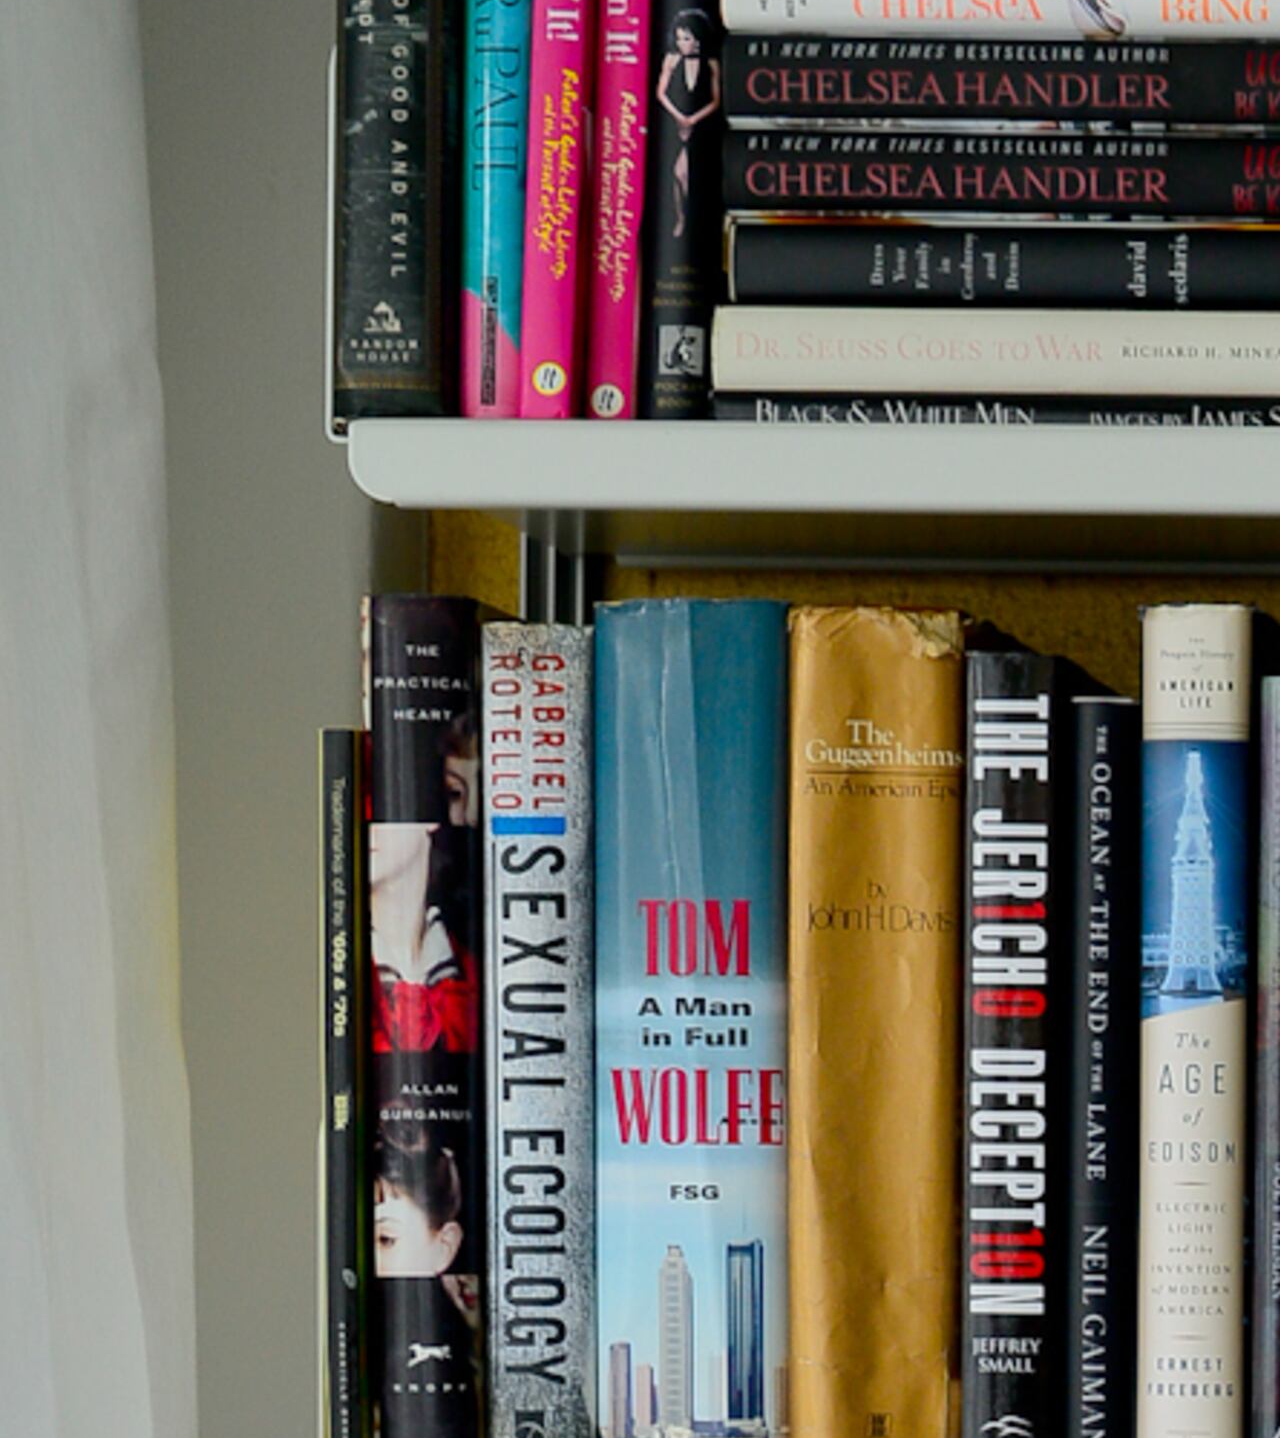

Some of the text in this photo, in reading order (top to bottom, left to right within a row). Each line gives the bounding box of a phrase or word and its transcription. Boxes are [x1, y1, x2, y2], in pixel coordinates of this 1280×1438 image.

[544, 13, 580, 43] It!
[746, 71, 1171, 110] CHELSEA HANDLER
[1121, 344, 1194, 358] RICHARD
[1200, 344, 1221, 358] H.
[638, 899, 752, 977] TOM
[638, 996, 752, 1018] A Man
[642, 1027, 749, 1048] in Full
[497, 844, 569, 1387] SEXUAL ECOLOGY
[669, 1184, 719, 1201] FSG
[1080, 1226, 1110, 1305] NEIL
[972, 1337, 1041, 1357] JEFFREY
[978, 1357, 1035, 1374] SMALL
